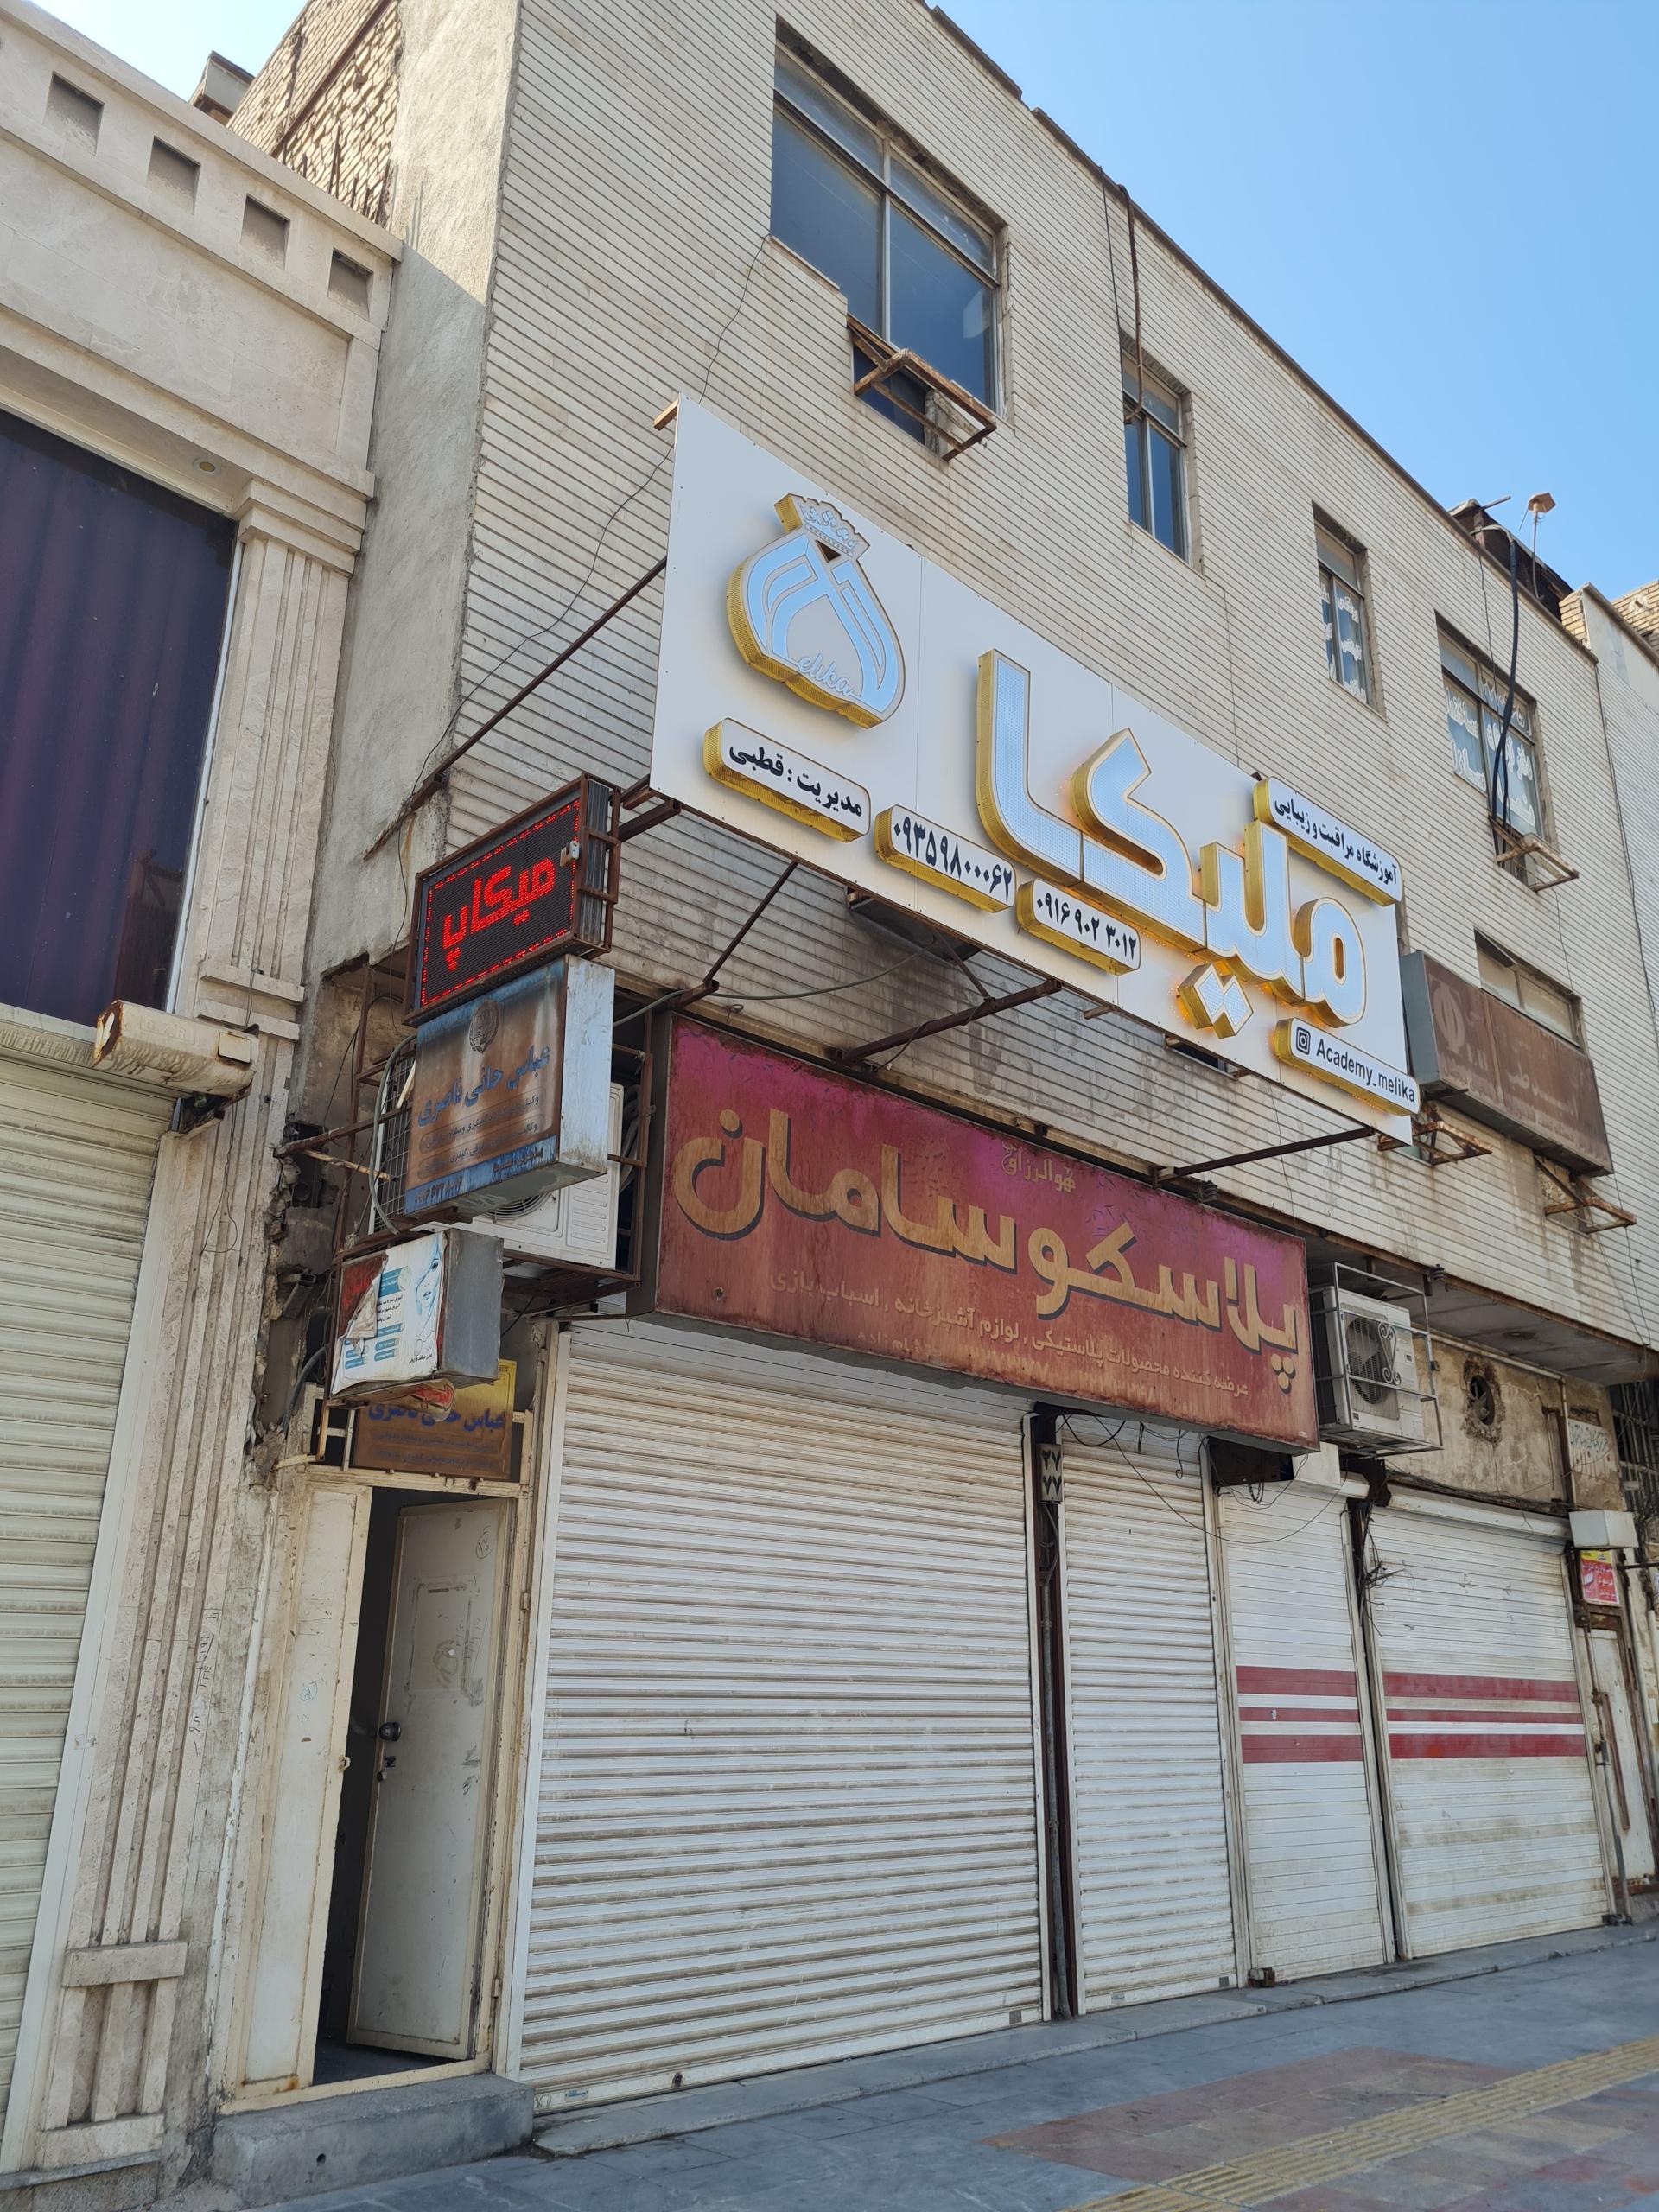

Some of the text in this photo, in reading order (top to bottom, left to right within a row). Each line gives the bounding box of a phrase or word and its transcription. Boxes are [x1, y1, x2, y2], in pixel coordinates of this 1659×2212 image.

[729, 741, 785, 779] قطبی
[976, 648, 1367, 1039] ملیکا
[1274, 798, 1397, 886] آموزشگاه مراقبت و زیبایی
[442, 857, 556, 973] میکاپ
[507, 1046, 550, 1091] عباس
[1316, 1039, 1415, 1104] Academy_melika
[671, 1109, 1299, 1395] پلاسکو سامان
[769, 1272, 815, 1296] بازی
[820, 1280, 880, 1309] اسباب
[980, 1316, 1020, 1344] لوازم
[1108, 1346, 1170, 1376] محصولات
[1173, 1362, 1211, 1387] کننده
[1214, 1374, 1250, 1399] عرضه
[463, 1408, 506, 1433] عباس
